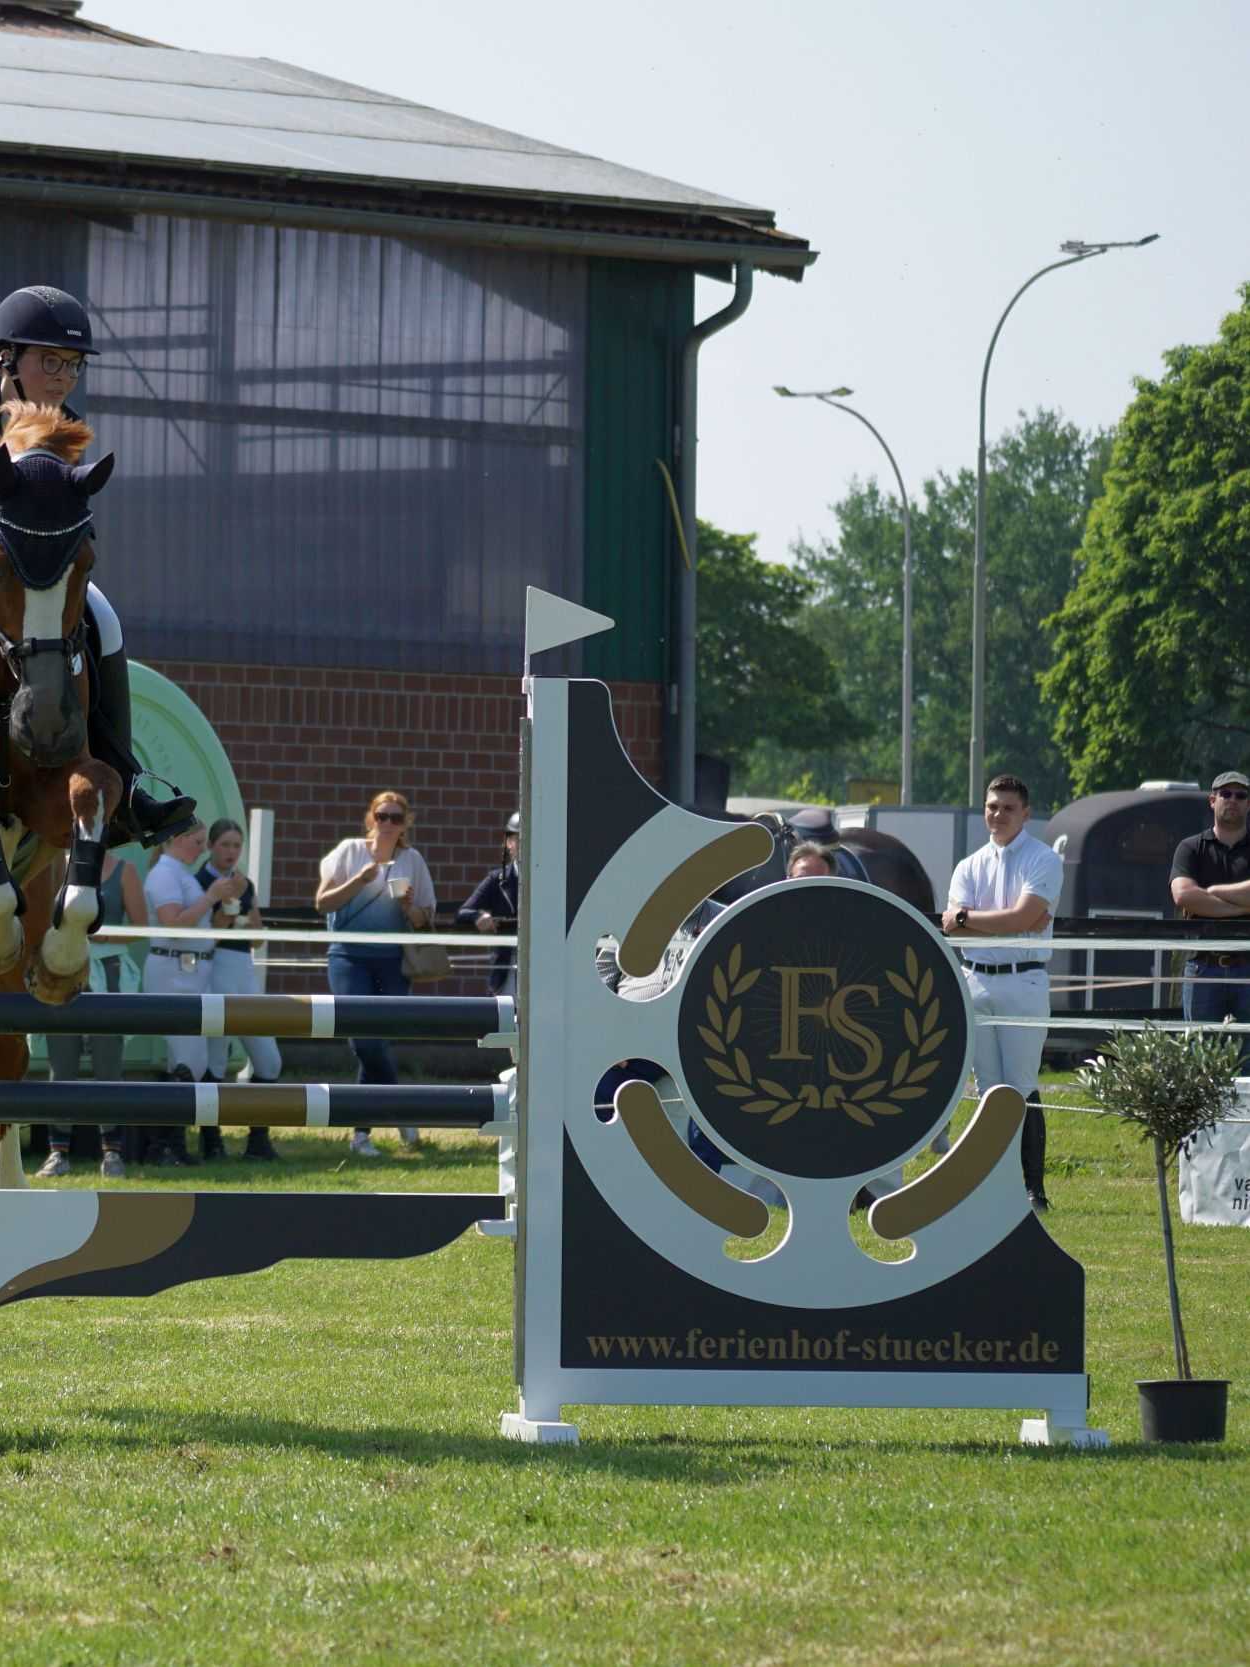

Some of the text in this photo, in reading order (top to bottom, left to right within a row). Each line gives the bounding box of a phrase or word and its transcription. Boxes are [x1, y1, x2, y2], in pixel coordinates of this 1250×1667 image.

[768, 965, 886, 1083] FS
[1232, 1194, 1250, 1210] ni
[586, 1327, 1060, 1363] www.ferienhof-stuecker.de
